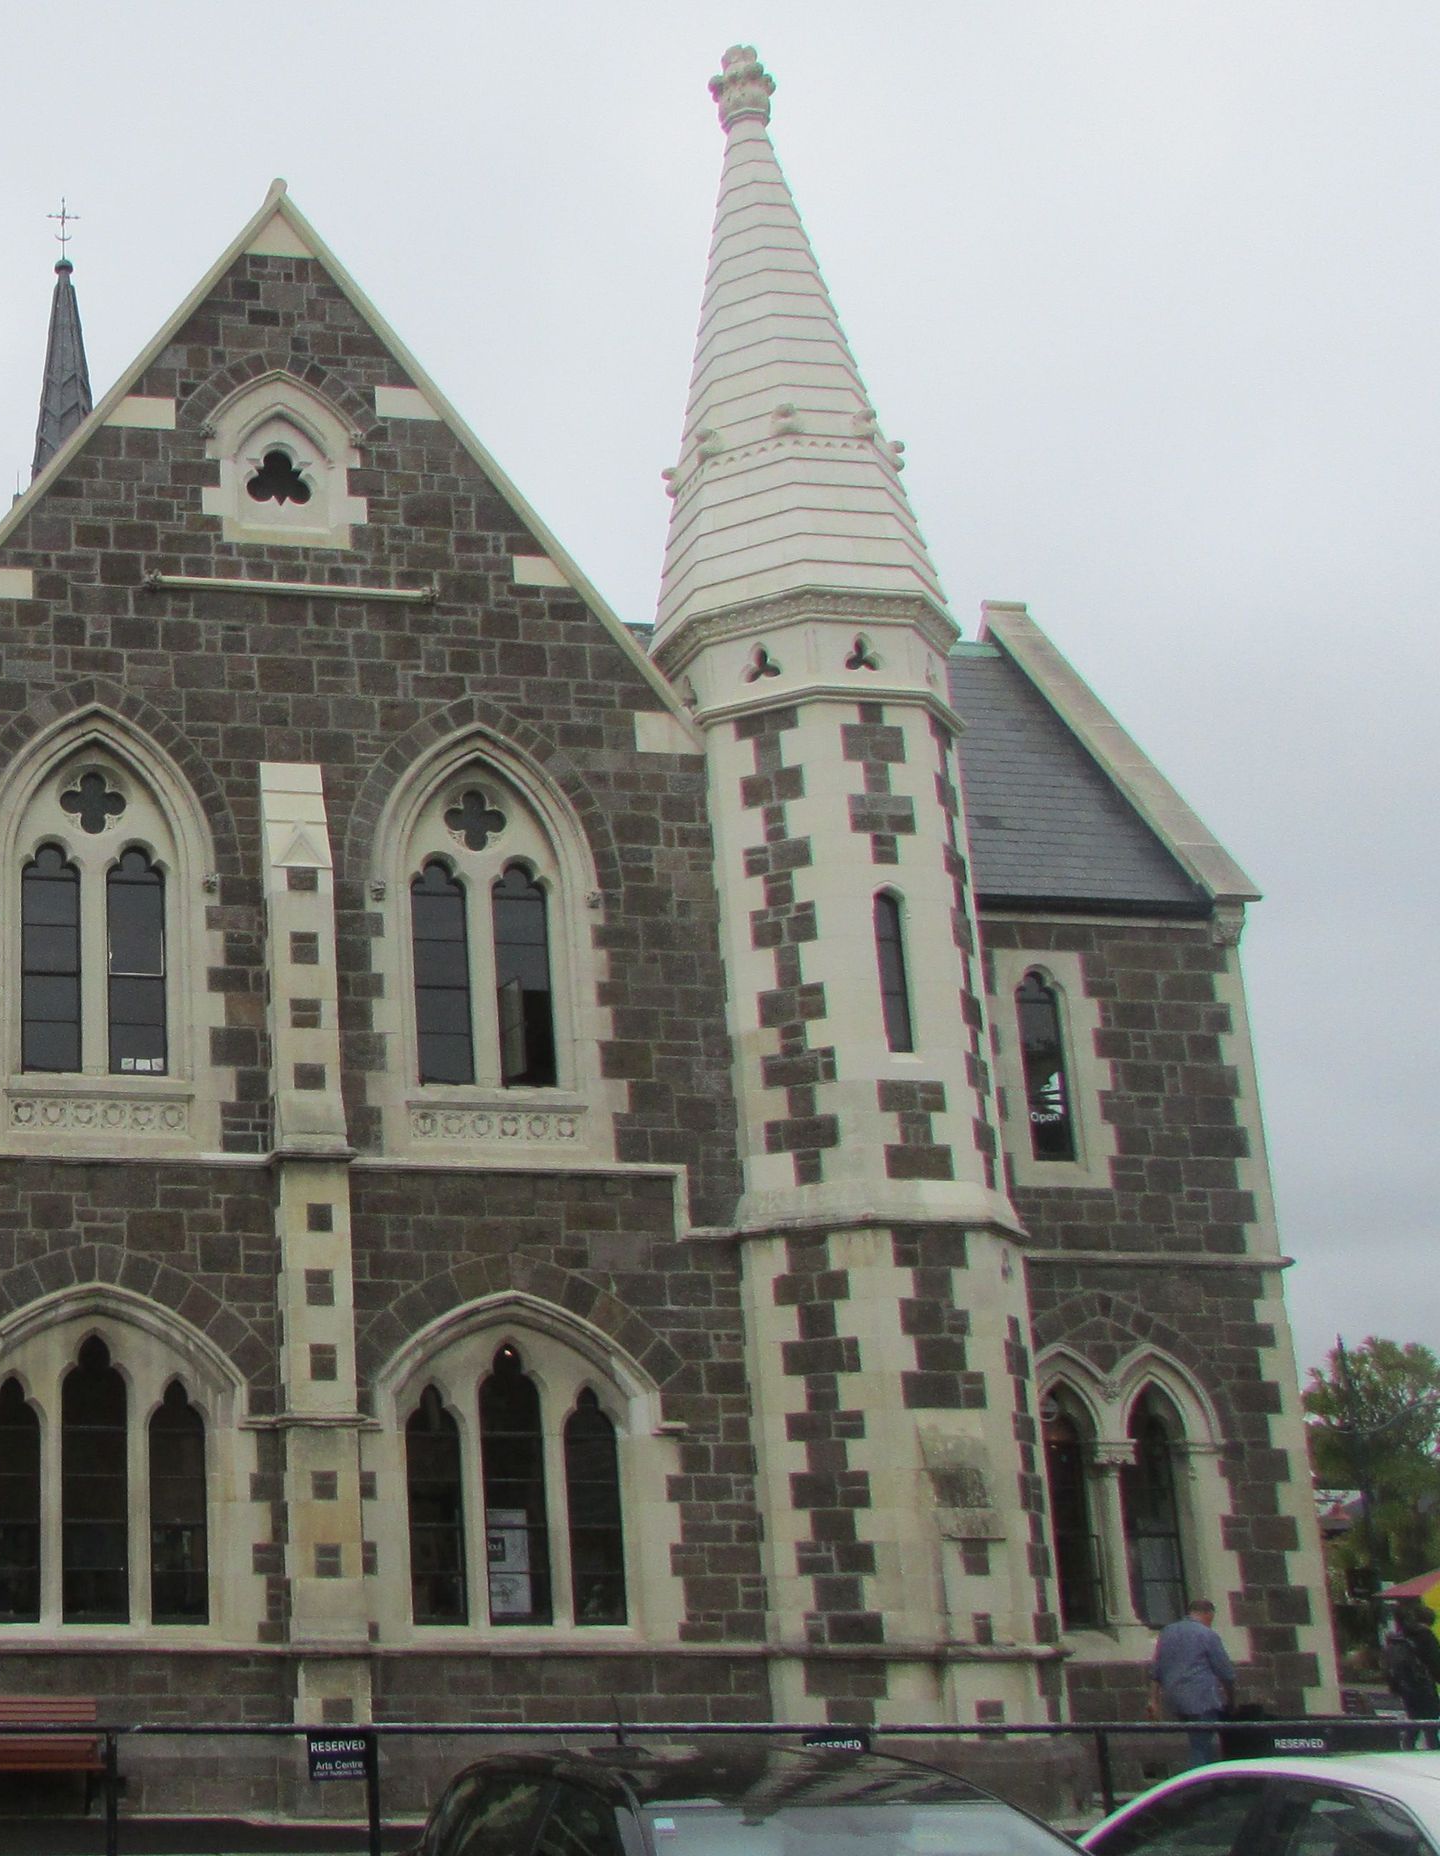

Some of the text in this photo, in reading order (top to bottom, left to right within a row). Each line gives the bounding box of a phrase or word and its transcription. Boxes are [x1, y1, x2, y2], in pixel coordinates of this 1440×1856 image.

[1030, 1111, 1060, 1124] Open
[310, 1740, 366, 1753] RESERVED
[1274, 1738, 1324, 1749] RESERVED
[315, 1760, 364, 1771] Arts Centre
